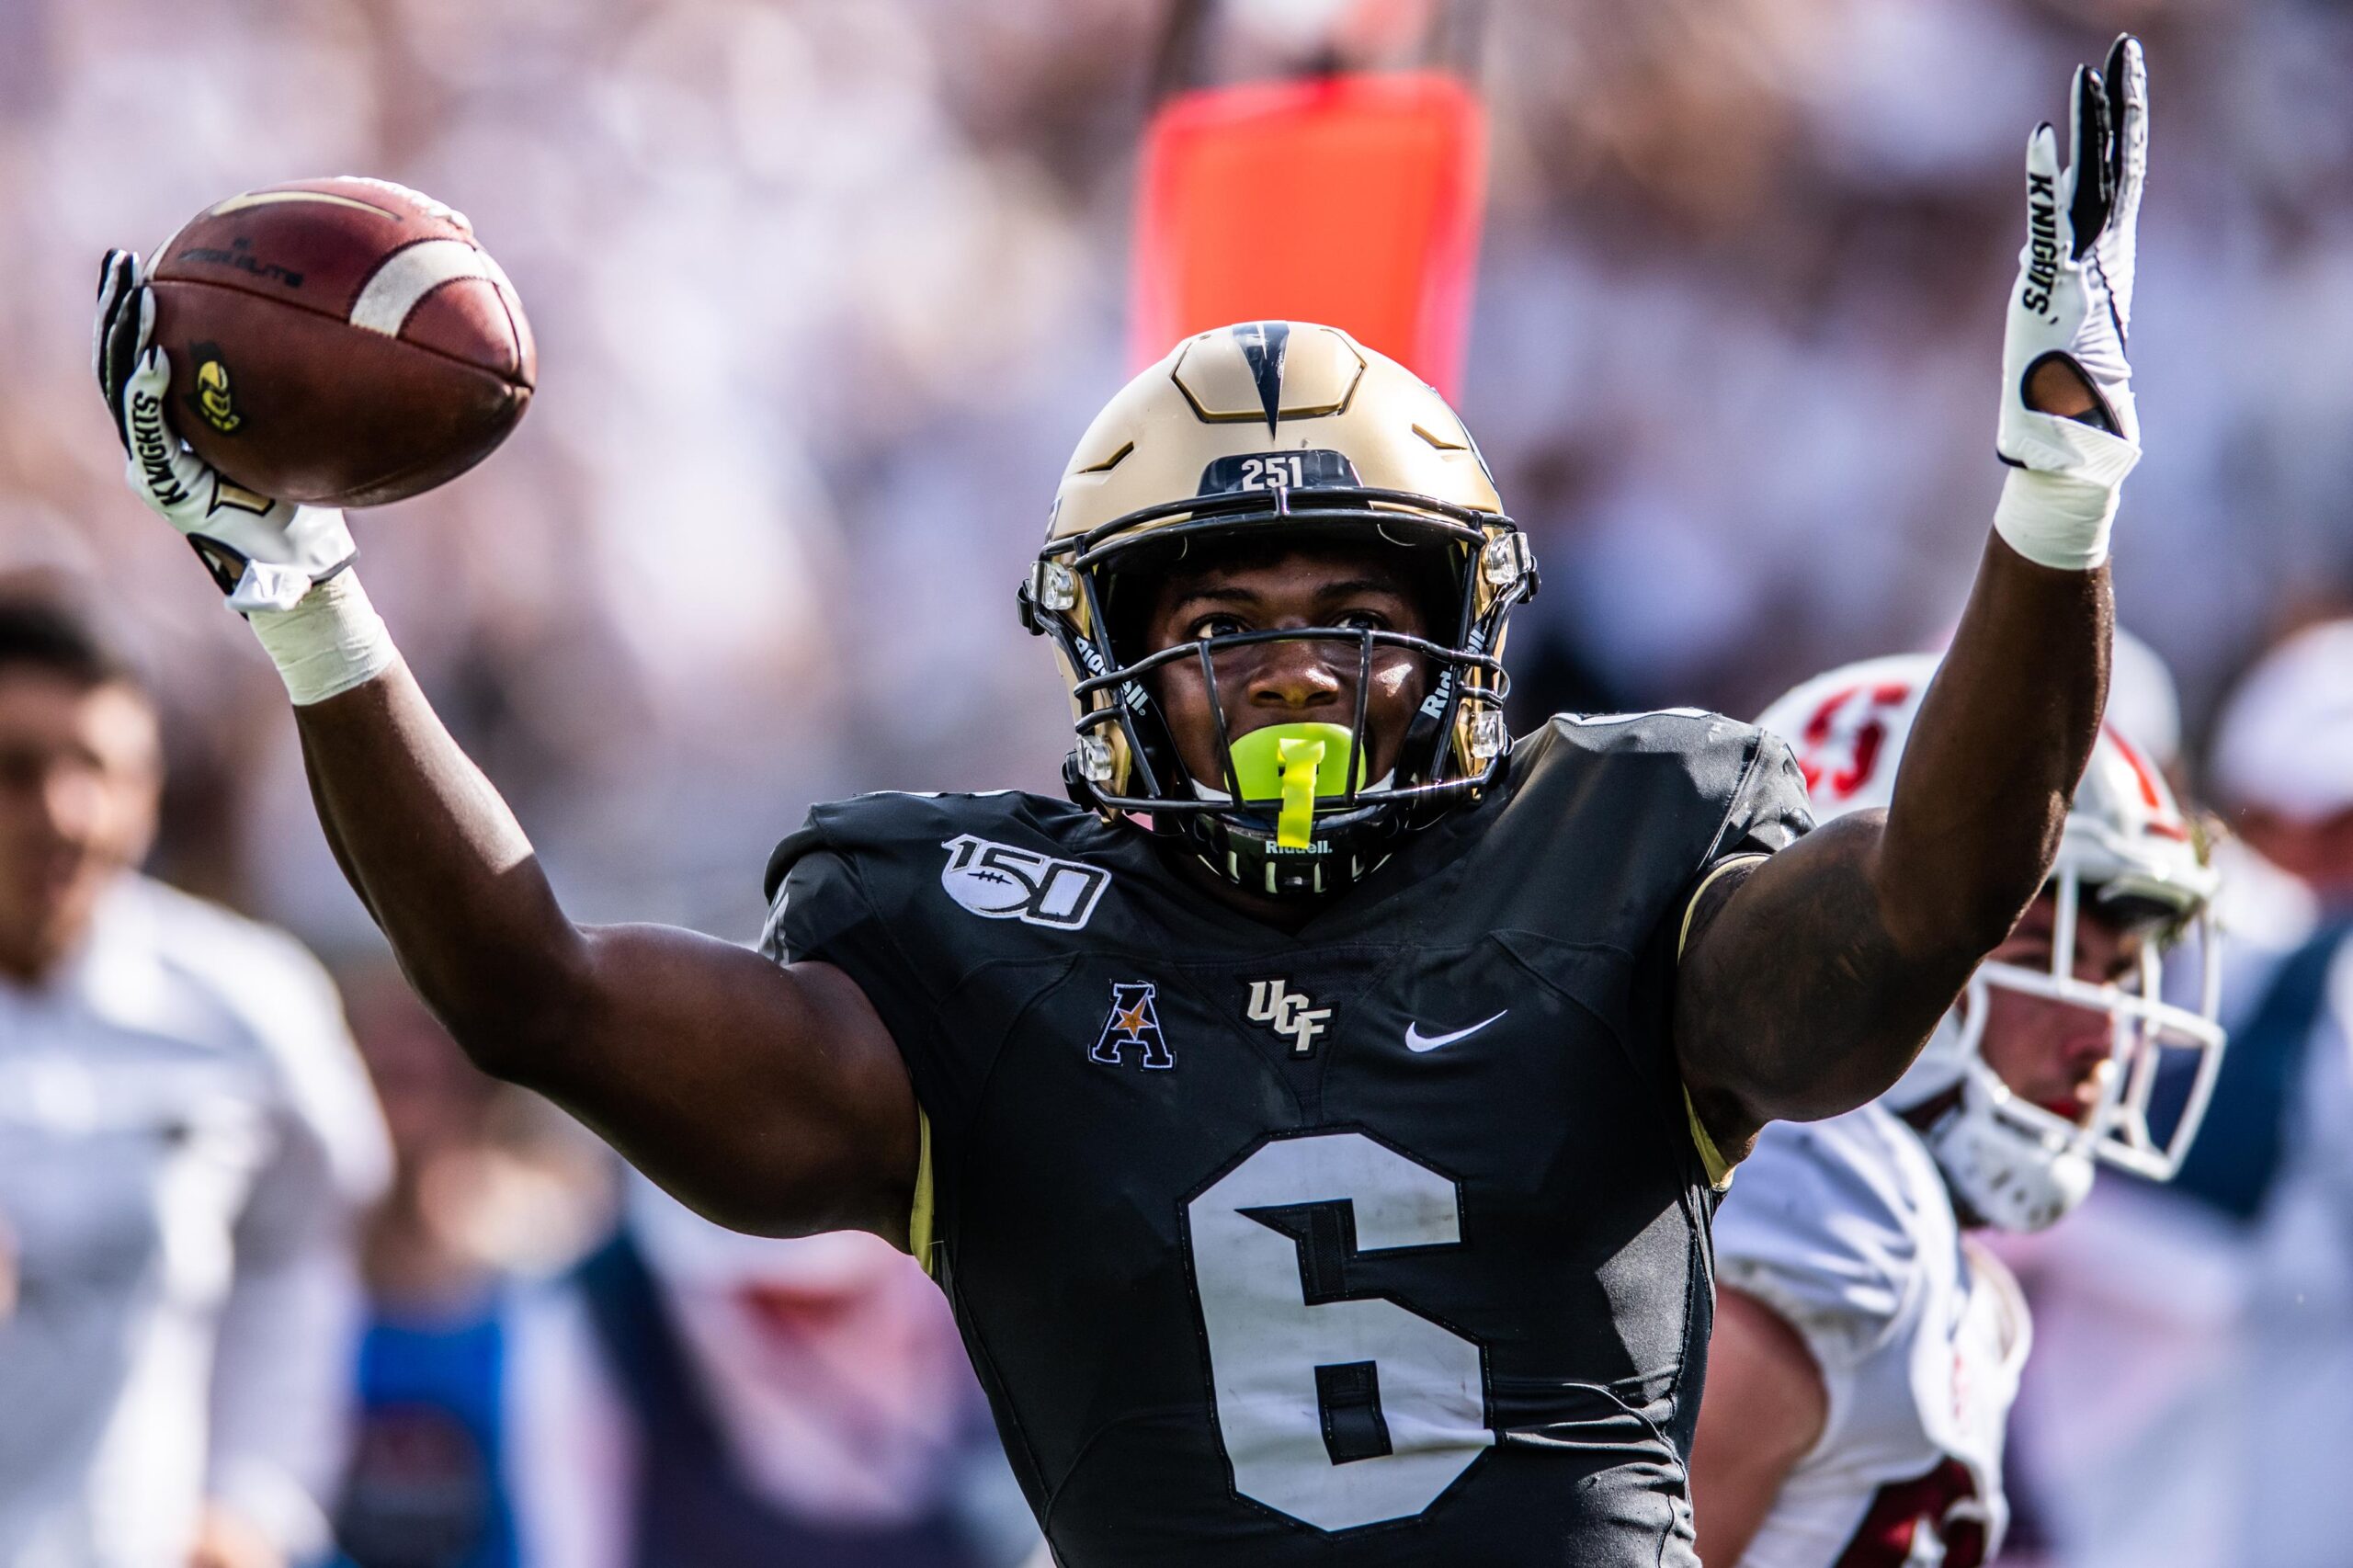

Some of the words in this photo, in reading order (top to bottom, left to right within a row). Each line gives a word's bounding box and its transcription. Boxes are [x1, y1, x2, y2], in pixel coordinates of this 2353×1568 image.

[2022, 172, 2059, 316] KNIGHTS
[132, 389, 190, 507] KNIGHTS
[1241, 456, 1303, 492] 251
[1419, 629, 1485, 720] Ridll
[951, 838, 1106, 926] 150
[1246, 979, 1332, 1051] UCF
[1188, 1132, 1495, 1532] 6
